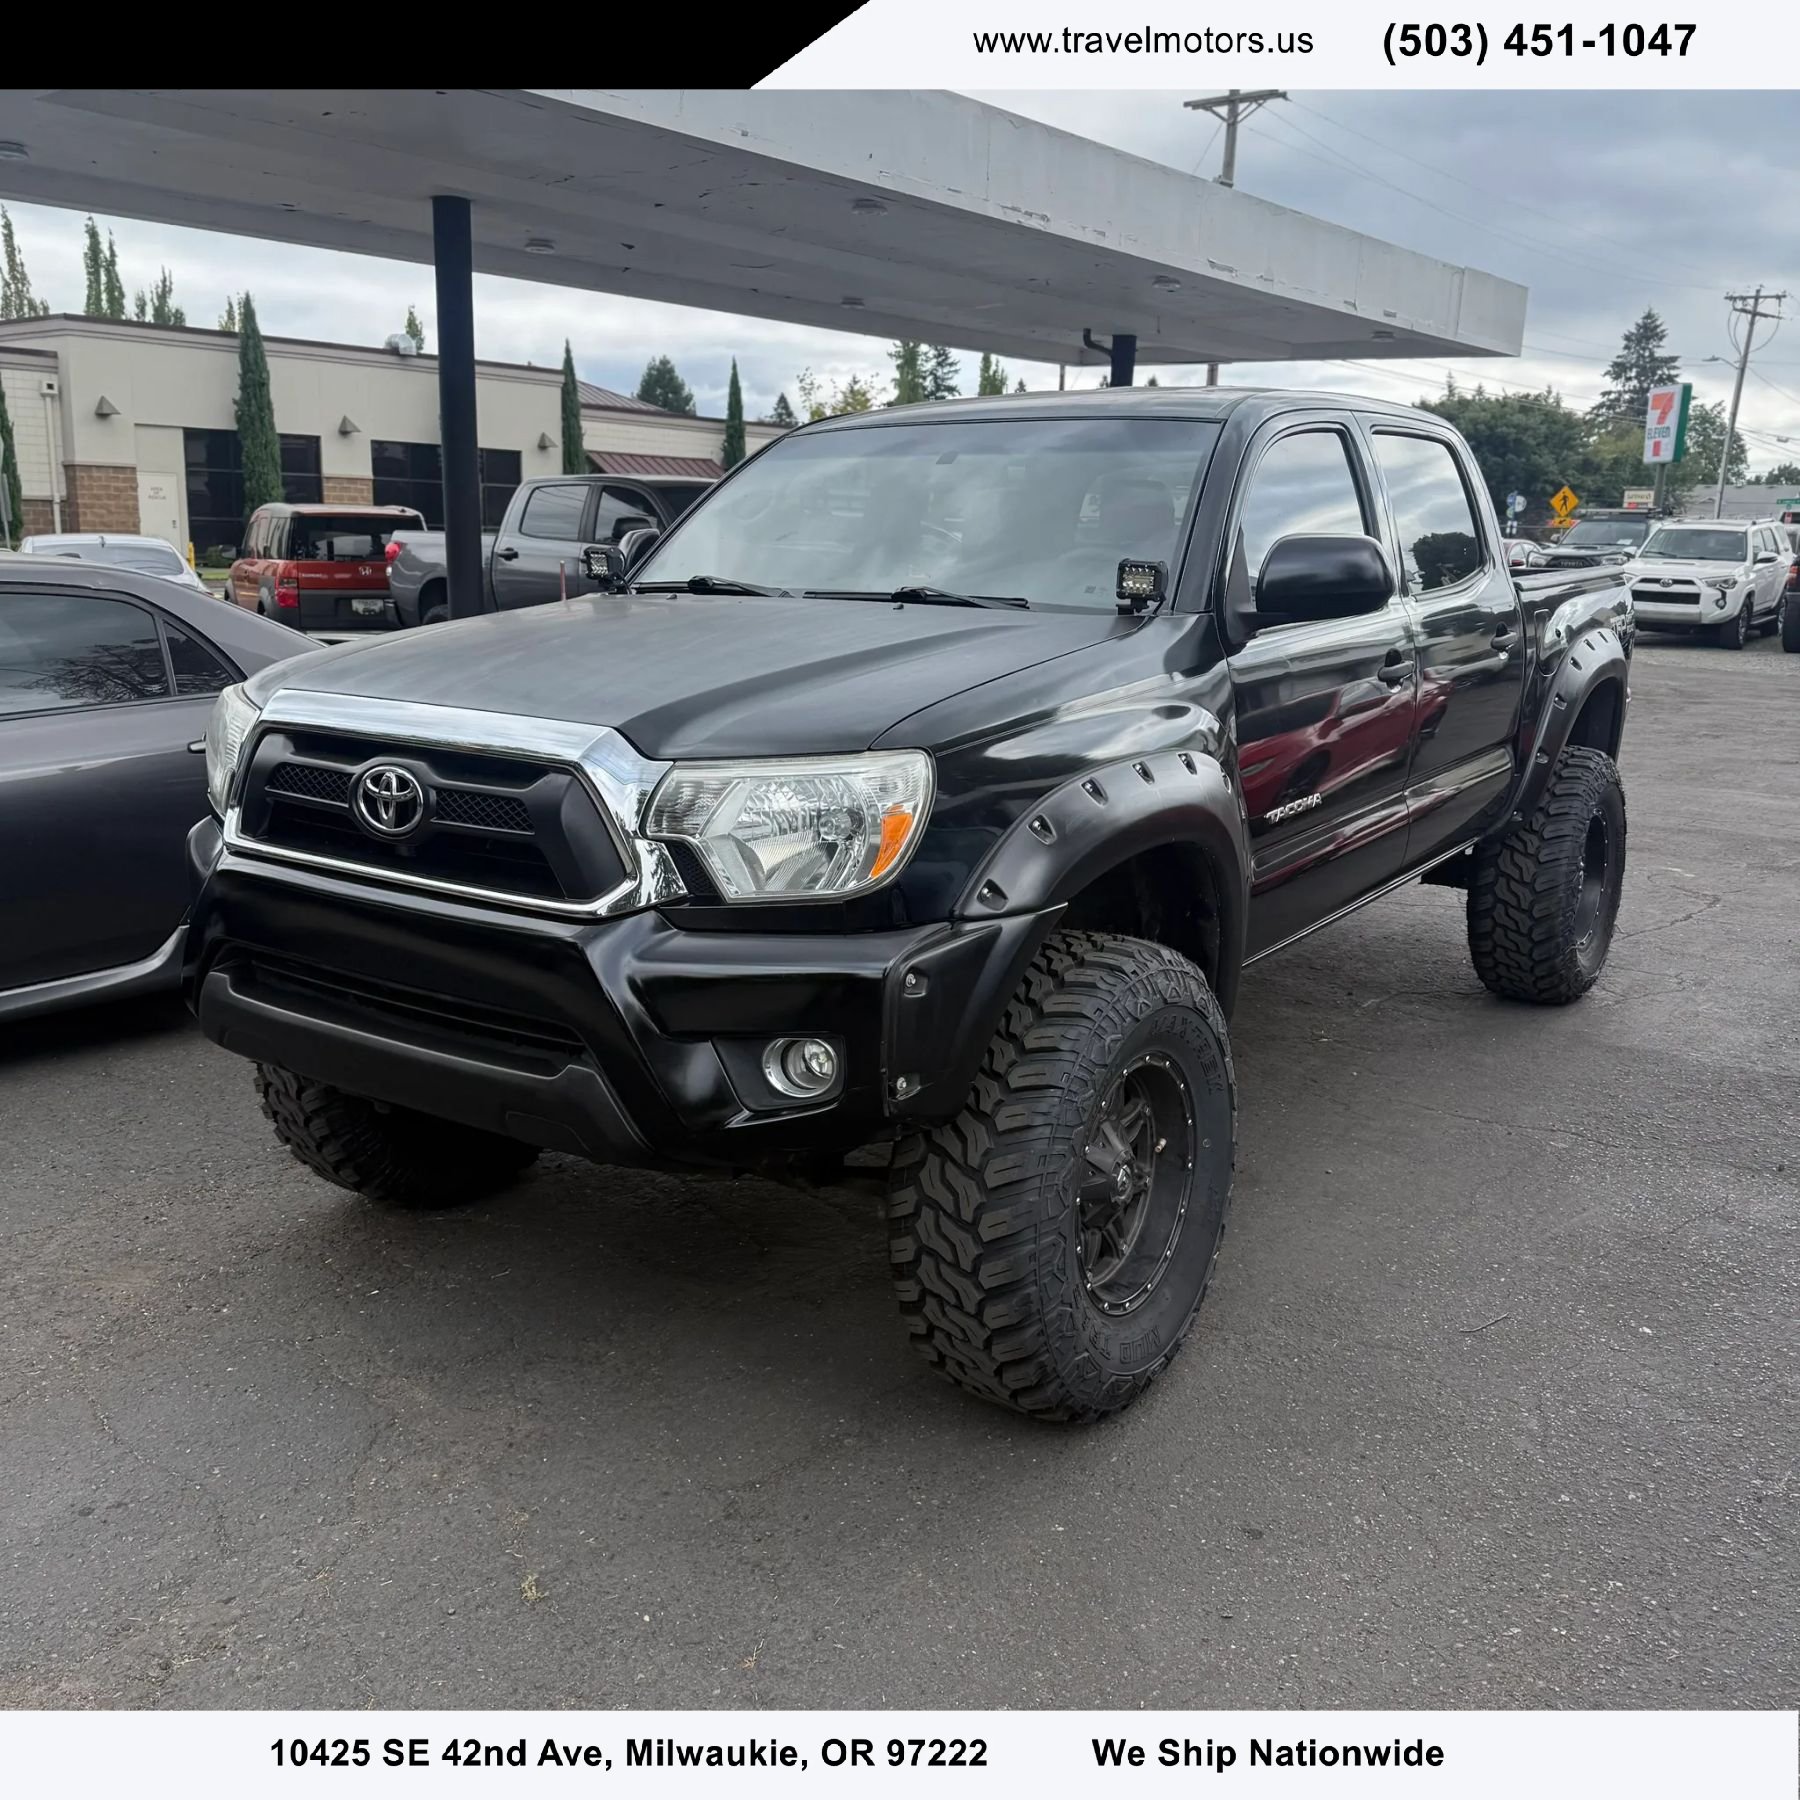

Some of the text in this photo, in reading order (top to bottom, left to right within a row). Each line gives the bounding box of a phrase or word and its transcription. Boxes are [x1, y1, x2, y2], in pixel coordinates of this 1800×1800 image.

[1264, 793, 1323, 824] TACOMA
[1152, 1016, 1225, 1096] MAXTREK
[1119, 1325, 1161, 1364] MUD
